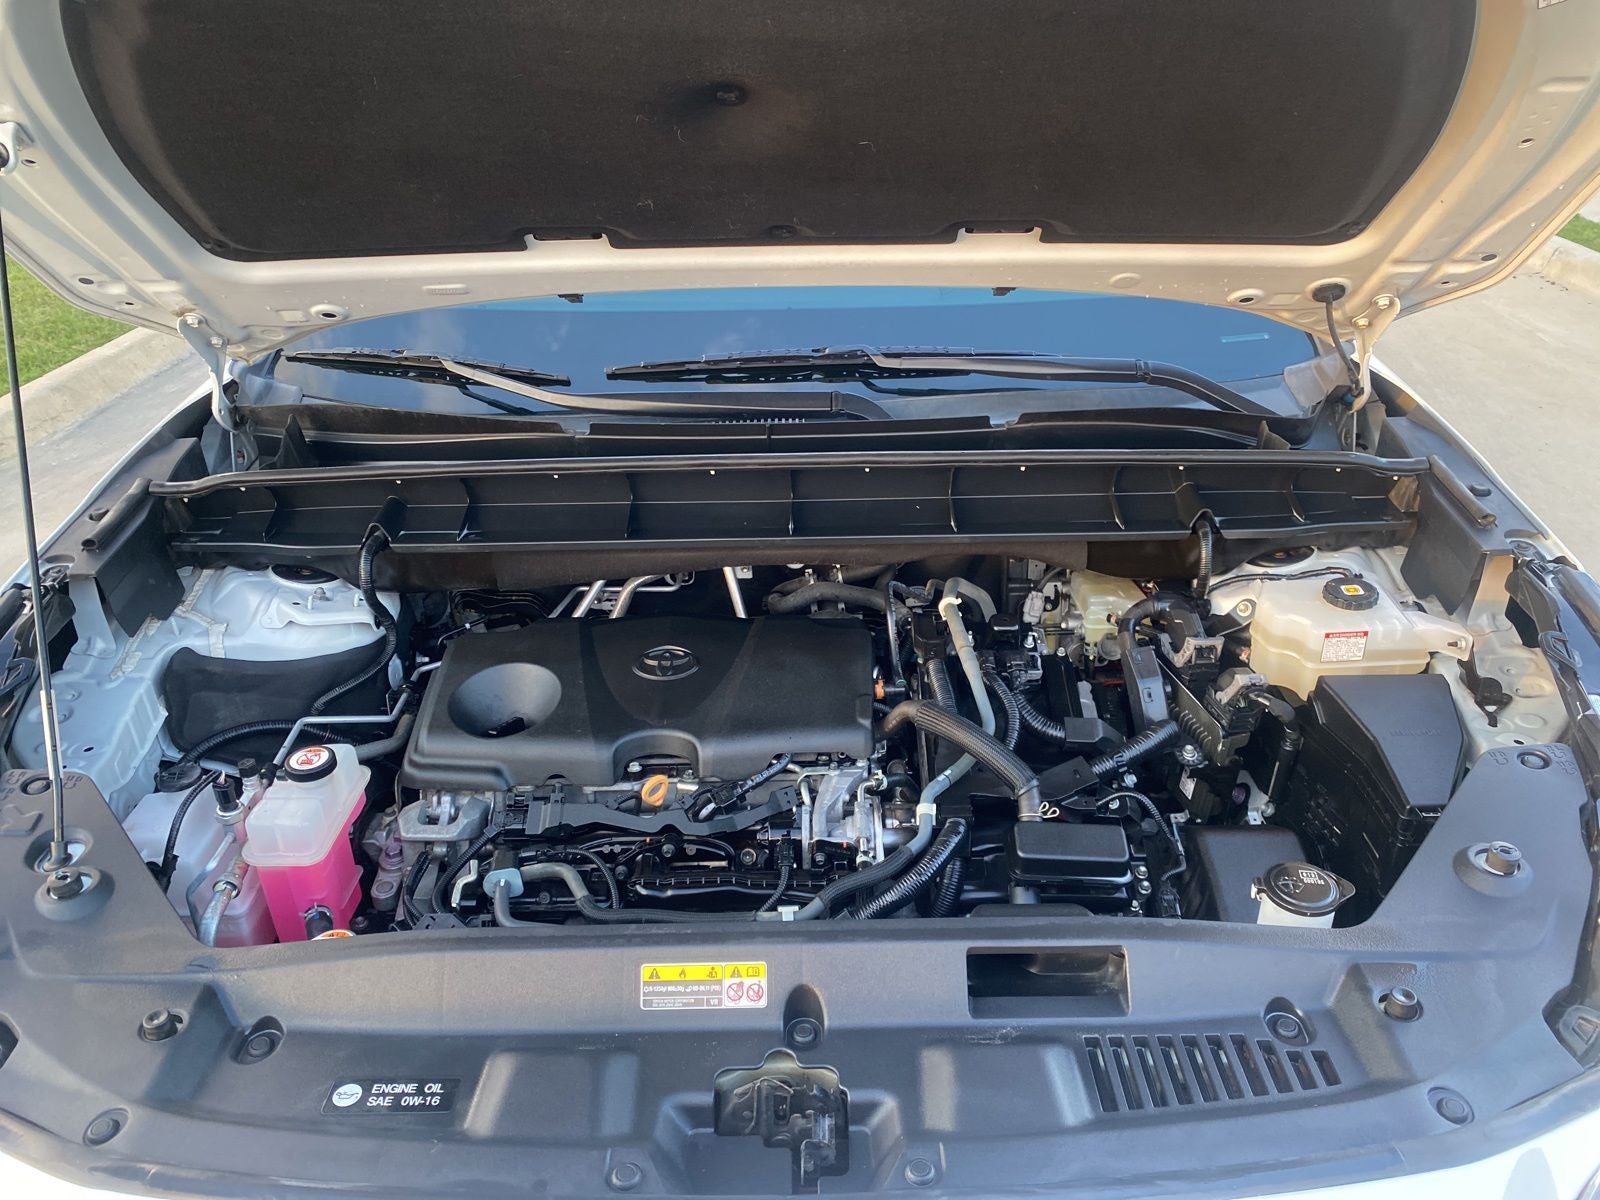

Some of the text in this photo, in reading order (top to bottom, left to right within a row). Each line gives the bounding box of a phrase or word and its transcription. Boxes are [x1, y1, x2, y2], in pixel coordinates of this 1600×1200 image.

[371, 1083, 444, 1094] ENGINE OIL
[366, 1096, 441, 1106] SAE 0W-16
